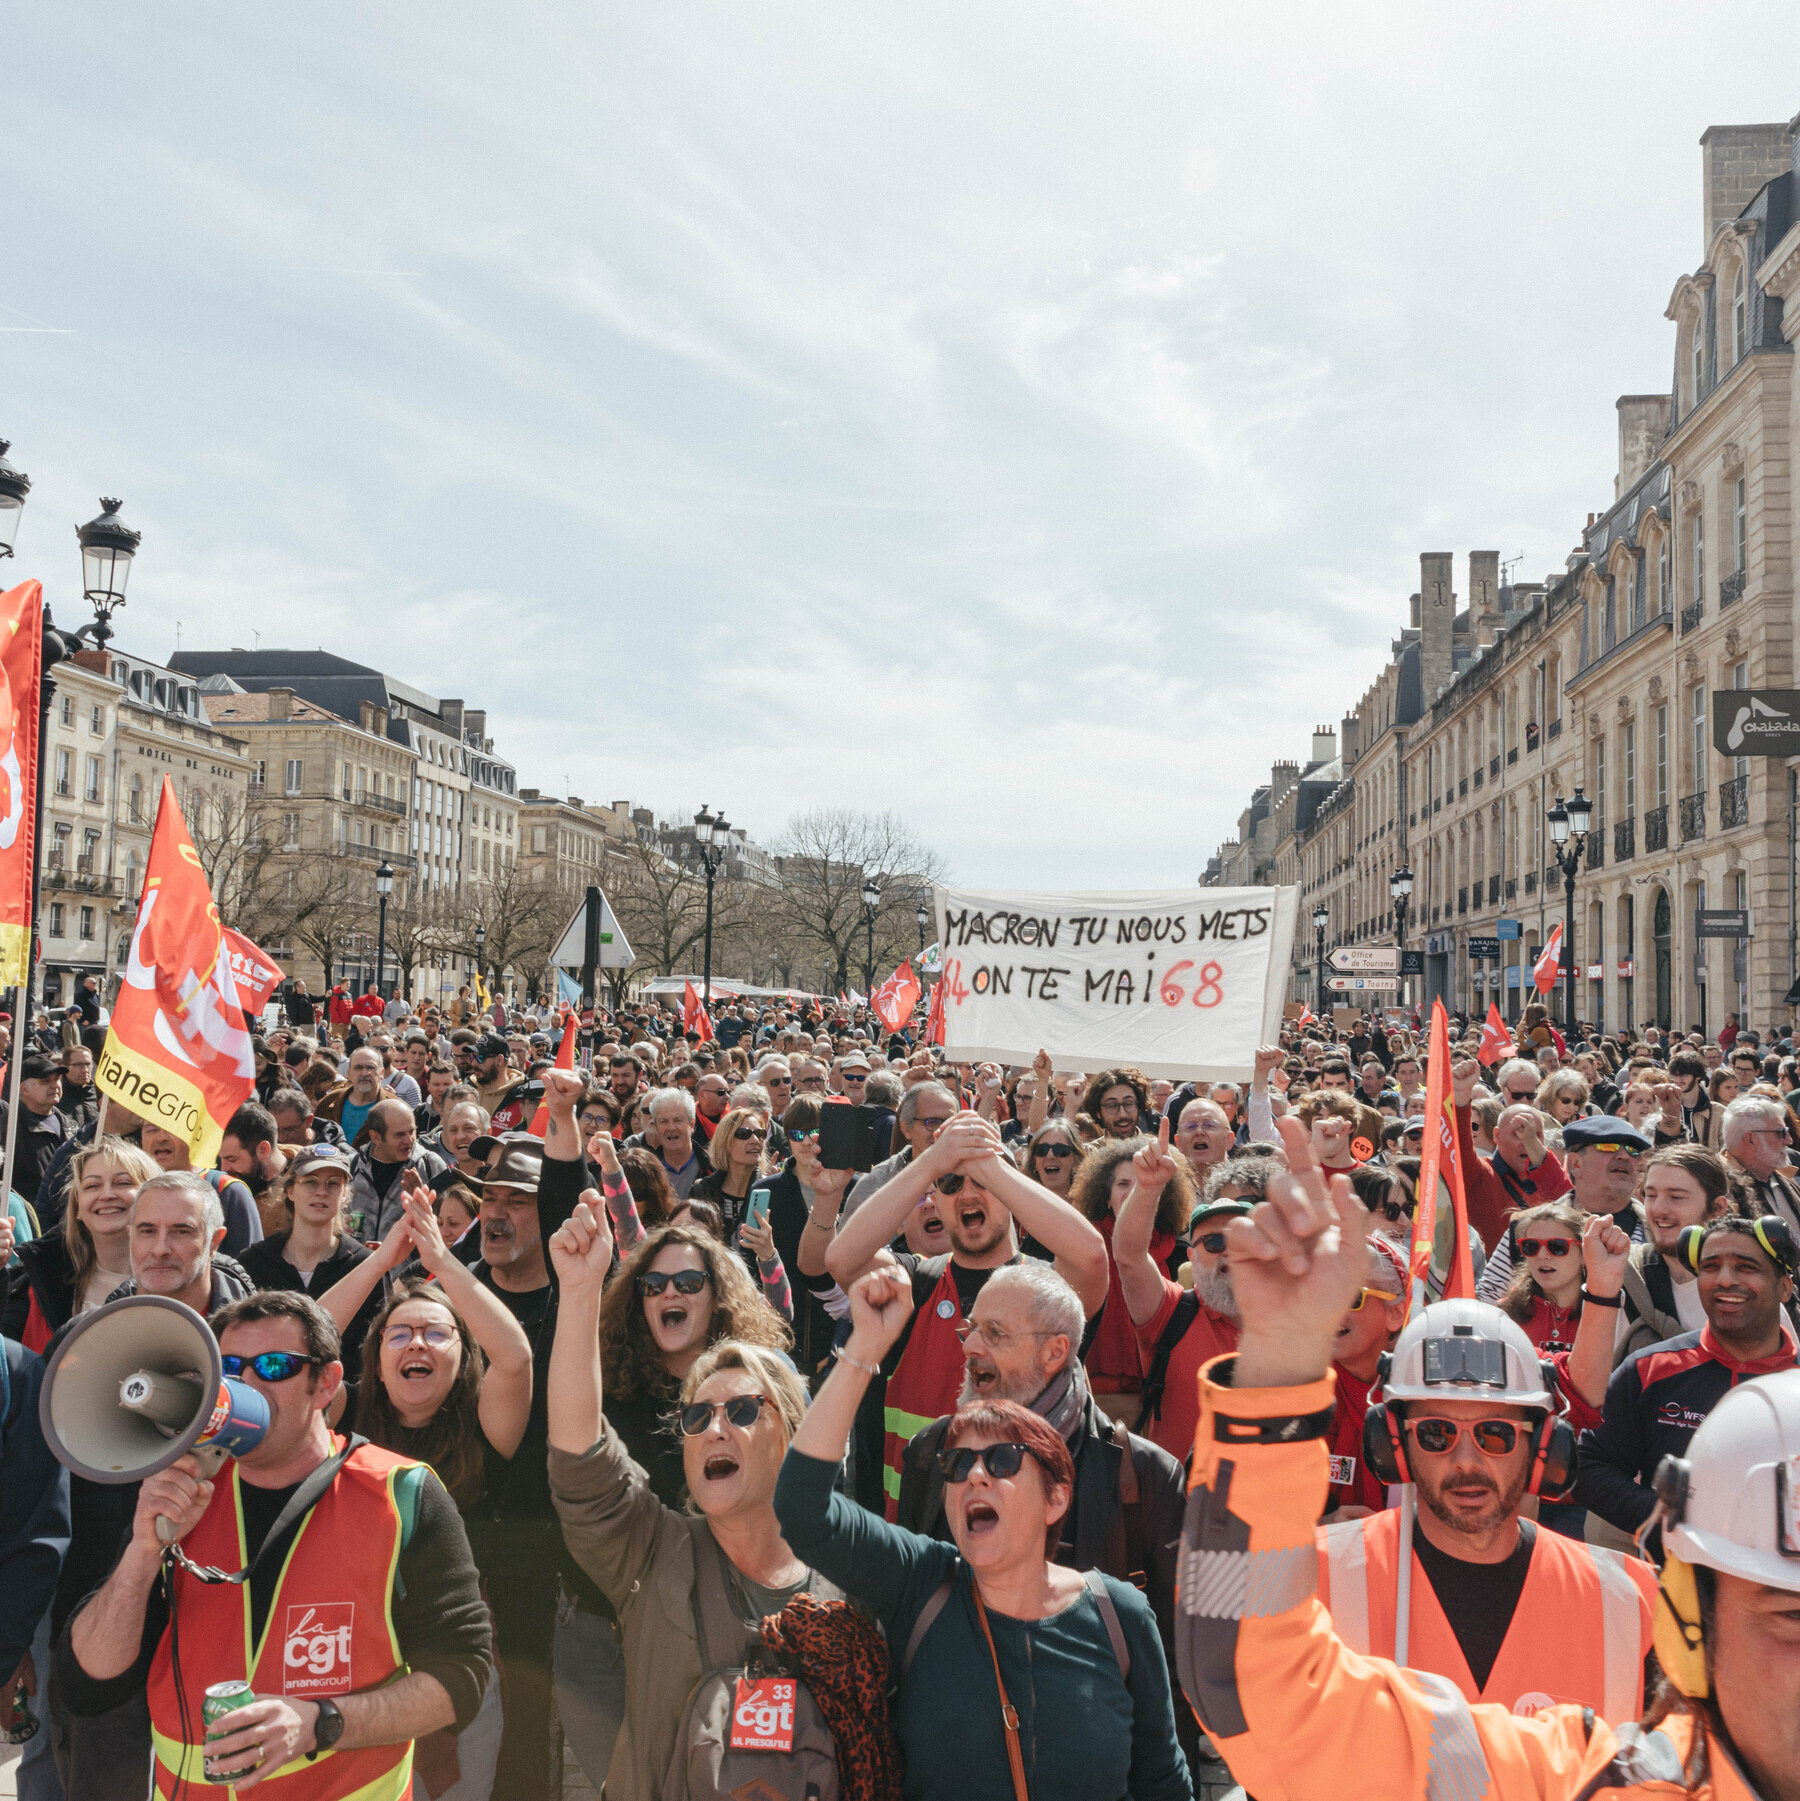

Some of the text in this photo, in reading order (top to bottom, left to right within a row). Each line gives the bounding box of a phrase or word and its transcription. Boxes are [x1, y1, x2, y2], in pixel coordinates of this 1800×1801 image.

[139, 746, 172, 763] HOTEL
[186, 759, 198, 769] DE
[945, 907, 1271, 948] MACRON TU NOUS METS
[1351, 951, 1373, 959] Office
[1363, 960, 1394, 968] Tourisme
[972, 966, 1013, 996] ON
[1021, 967, 1070, 1000] TE
[1367, 980, 1394, 988] Tourny
[1354, 1141, 1371, 1154] CGT
[1684, 1411, 1706, 1422] WFS
[284, 1626, 351, 1674] cgt
[772, 1684, 792, 1701] 33
[736, 1702, 793, 1736] cgt
[733, 1737, 744, 1746] UL
